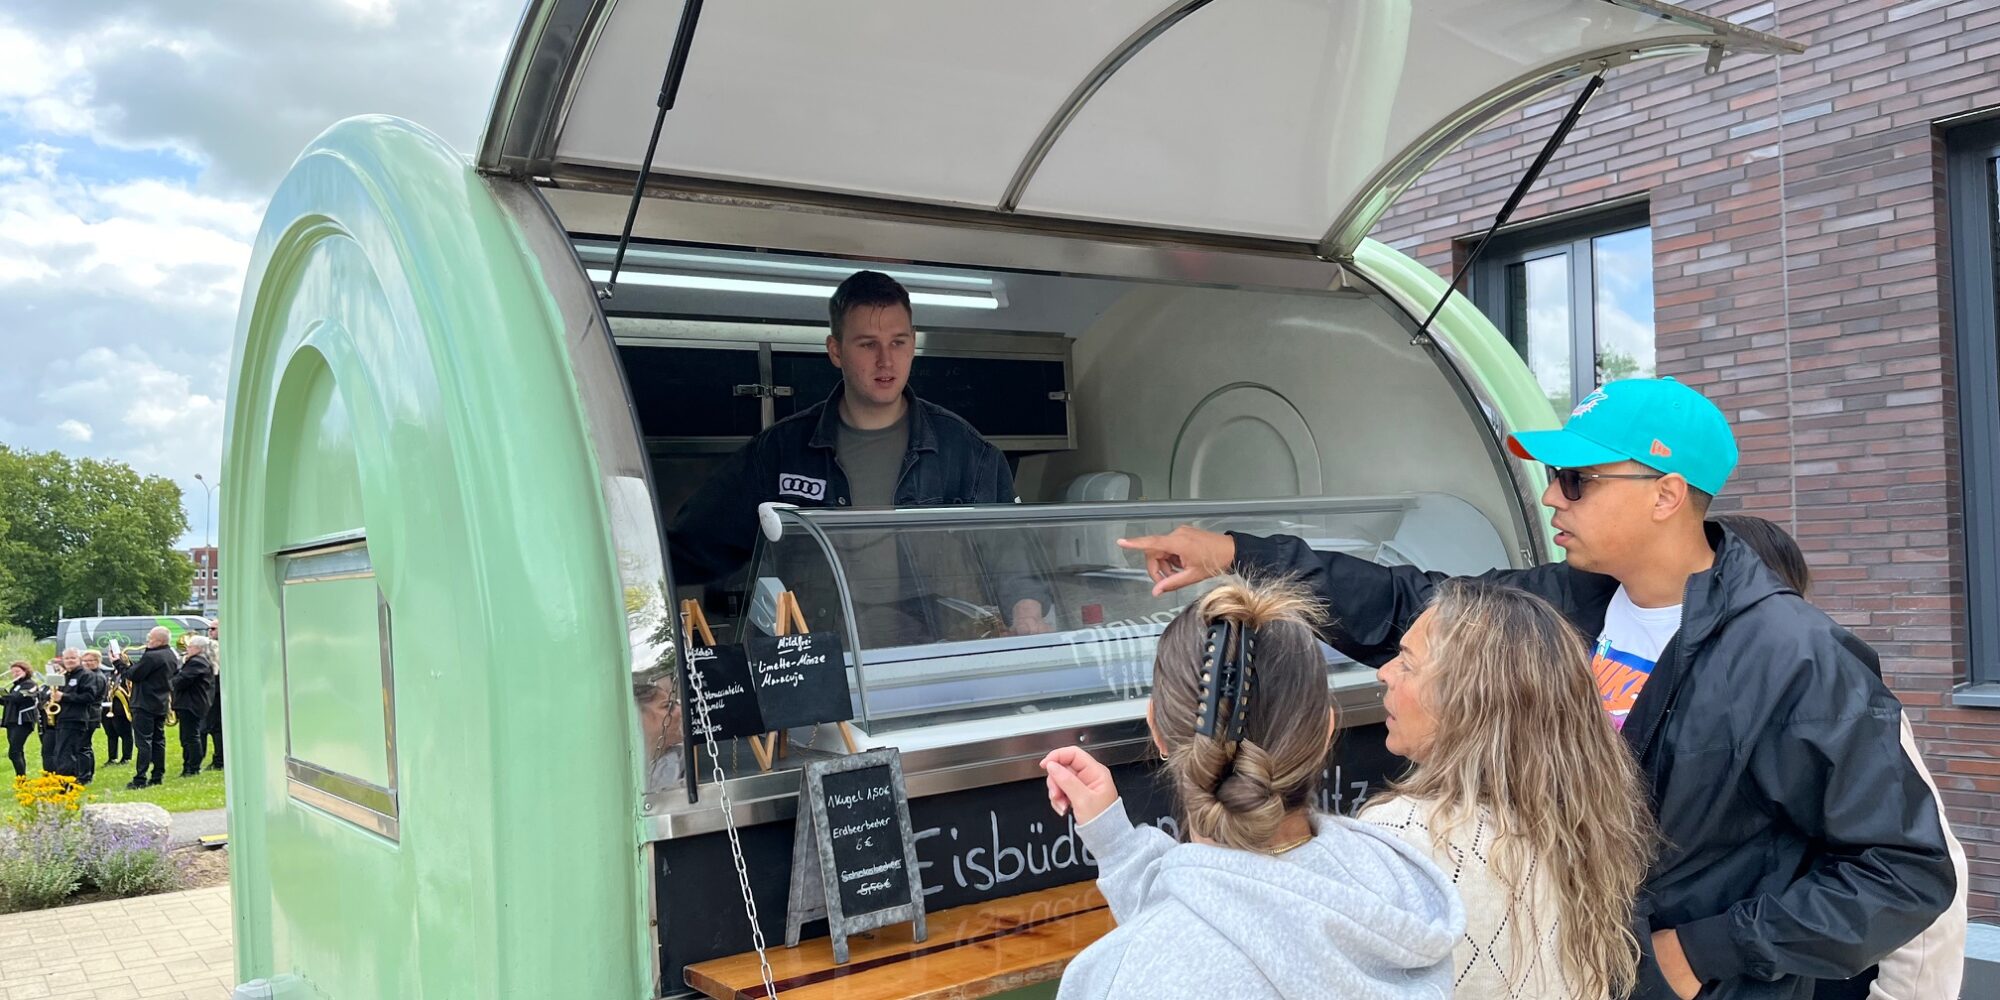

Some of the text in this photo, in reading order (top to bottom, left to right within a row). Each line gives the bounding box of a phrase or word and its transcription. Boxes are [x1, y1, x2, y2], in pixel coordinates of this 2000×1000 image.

[761, 672, 804, 687] Maracuja
[867, 785, 890, 800] 1,50€
[833, 817, 891, 839] Erdbeerbecher
